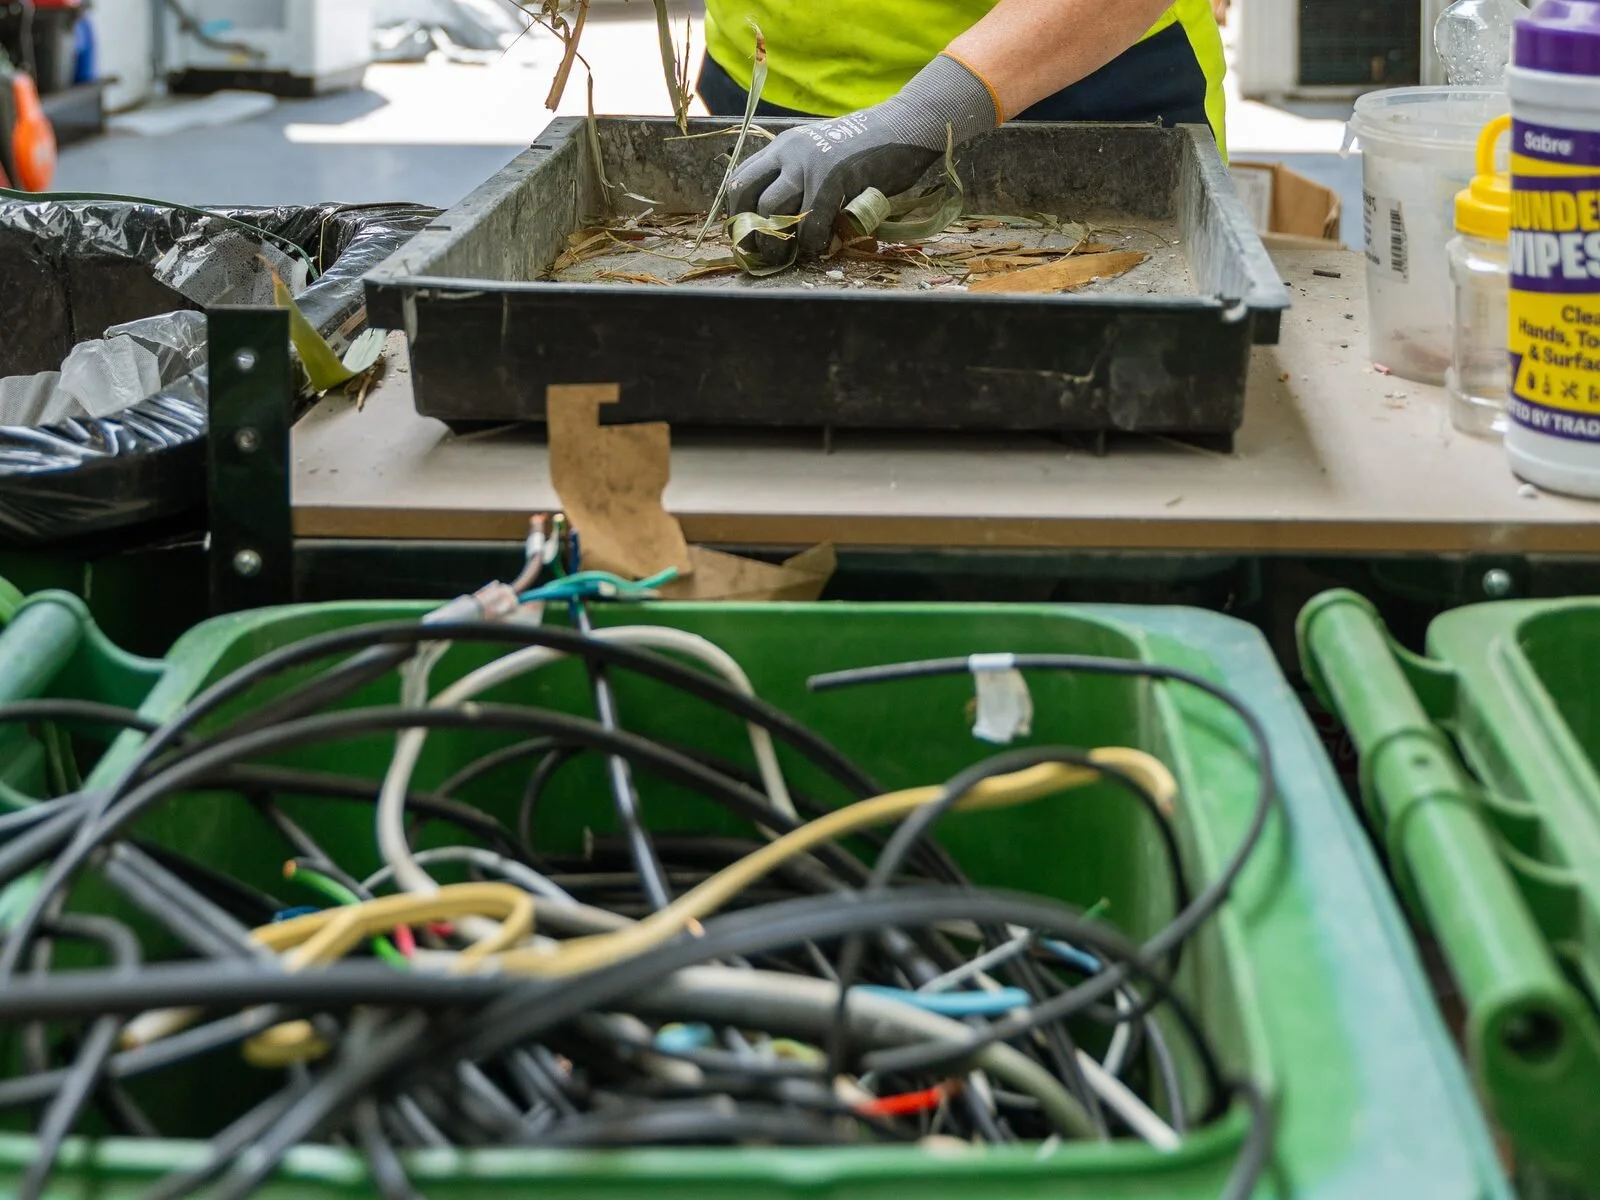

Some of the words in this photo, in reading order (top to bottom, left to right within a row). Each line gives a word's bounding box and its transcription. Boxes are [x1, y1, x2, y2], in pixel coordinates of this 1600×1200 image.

[1523, 130, 1573, 157] Sabre
[1518, 316, 1571, 348] Hands,
[1528, 343, 1540, 362] &
[1531, 407, 1552, 429] BY
